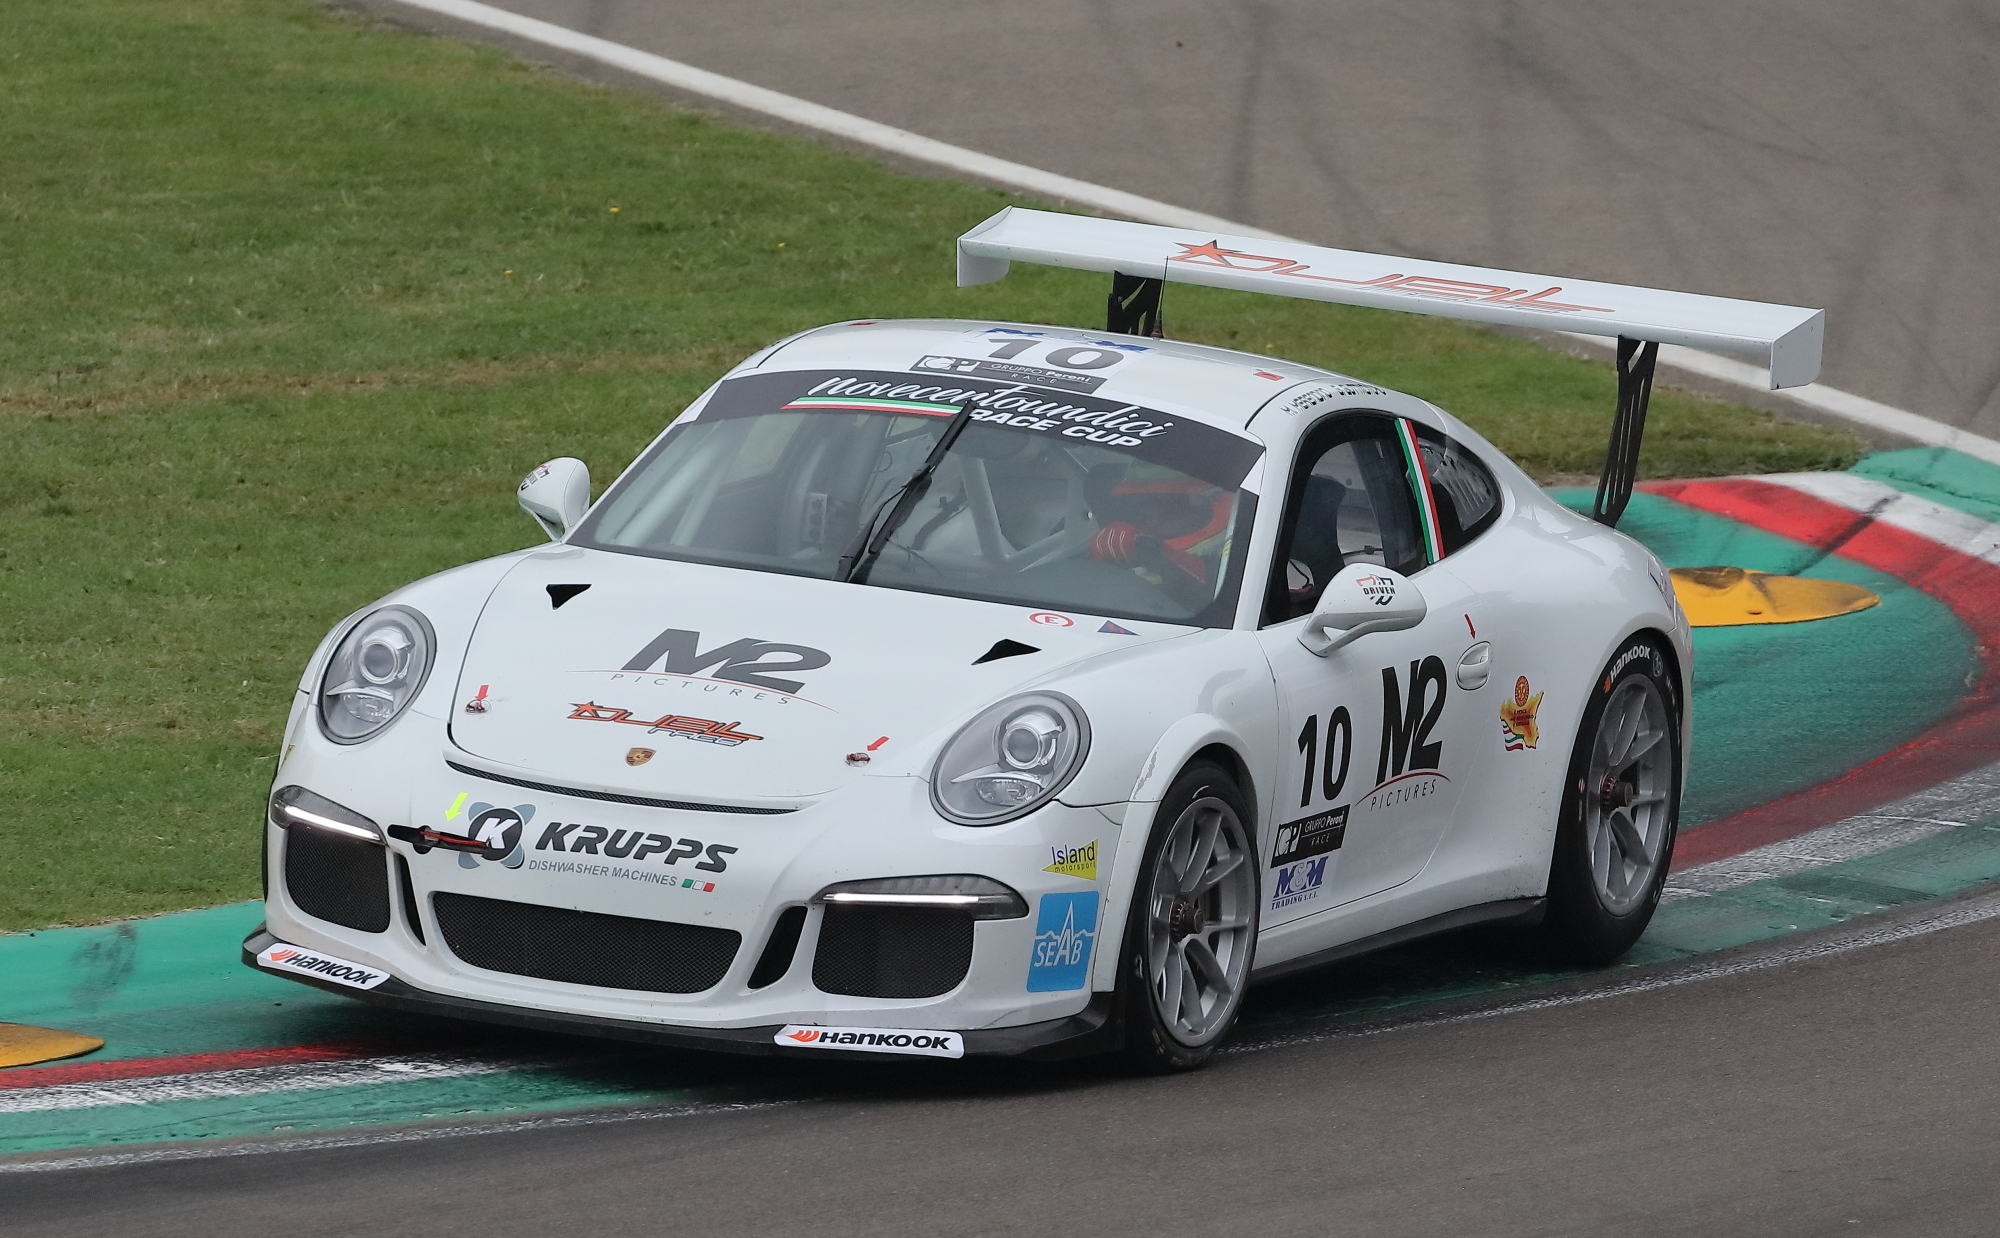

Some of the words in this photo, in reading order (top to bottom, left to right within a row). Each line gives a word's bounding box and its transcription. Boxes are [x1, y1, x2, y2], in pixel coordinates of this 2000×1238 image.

[987, 338, 1125, 371] 10
[990, 363, 1043, 374] GRUPPO
[1046, 371, 1092, 382] Peroni
[1011, 373, 1058, 384] RACE
[968, 408, 1062, 431] RACE
[1061, 425, 1143, 447] CUP
[621, 628, 832, 695] M2
[610, 673, 790, 705] PICTURES
[1375, 654, 1448, 788] M2
[1297, 705, 1353, 809] 10
[1370, 778, 1437, 811] PICTURES
[535, 822, 739, 874] KRUPPS
[1051, 841, 1095, 866] Island
[528, 860, 609, 877] DISHWASHER
[611, 867, 678, 887] MACHINES
[1054, 861, 1096, 873] motorsport
[1272, 855, 1329, 899] M&M
[1271, 894, 1303, 911] TRADING
[1033, 927, 1084, 968] SEAB
